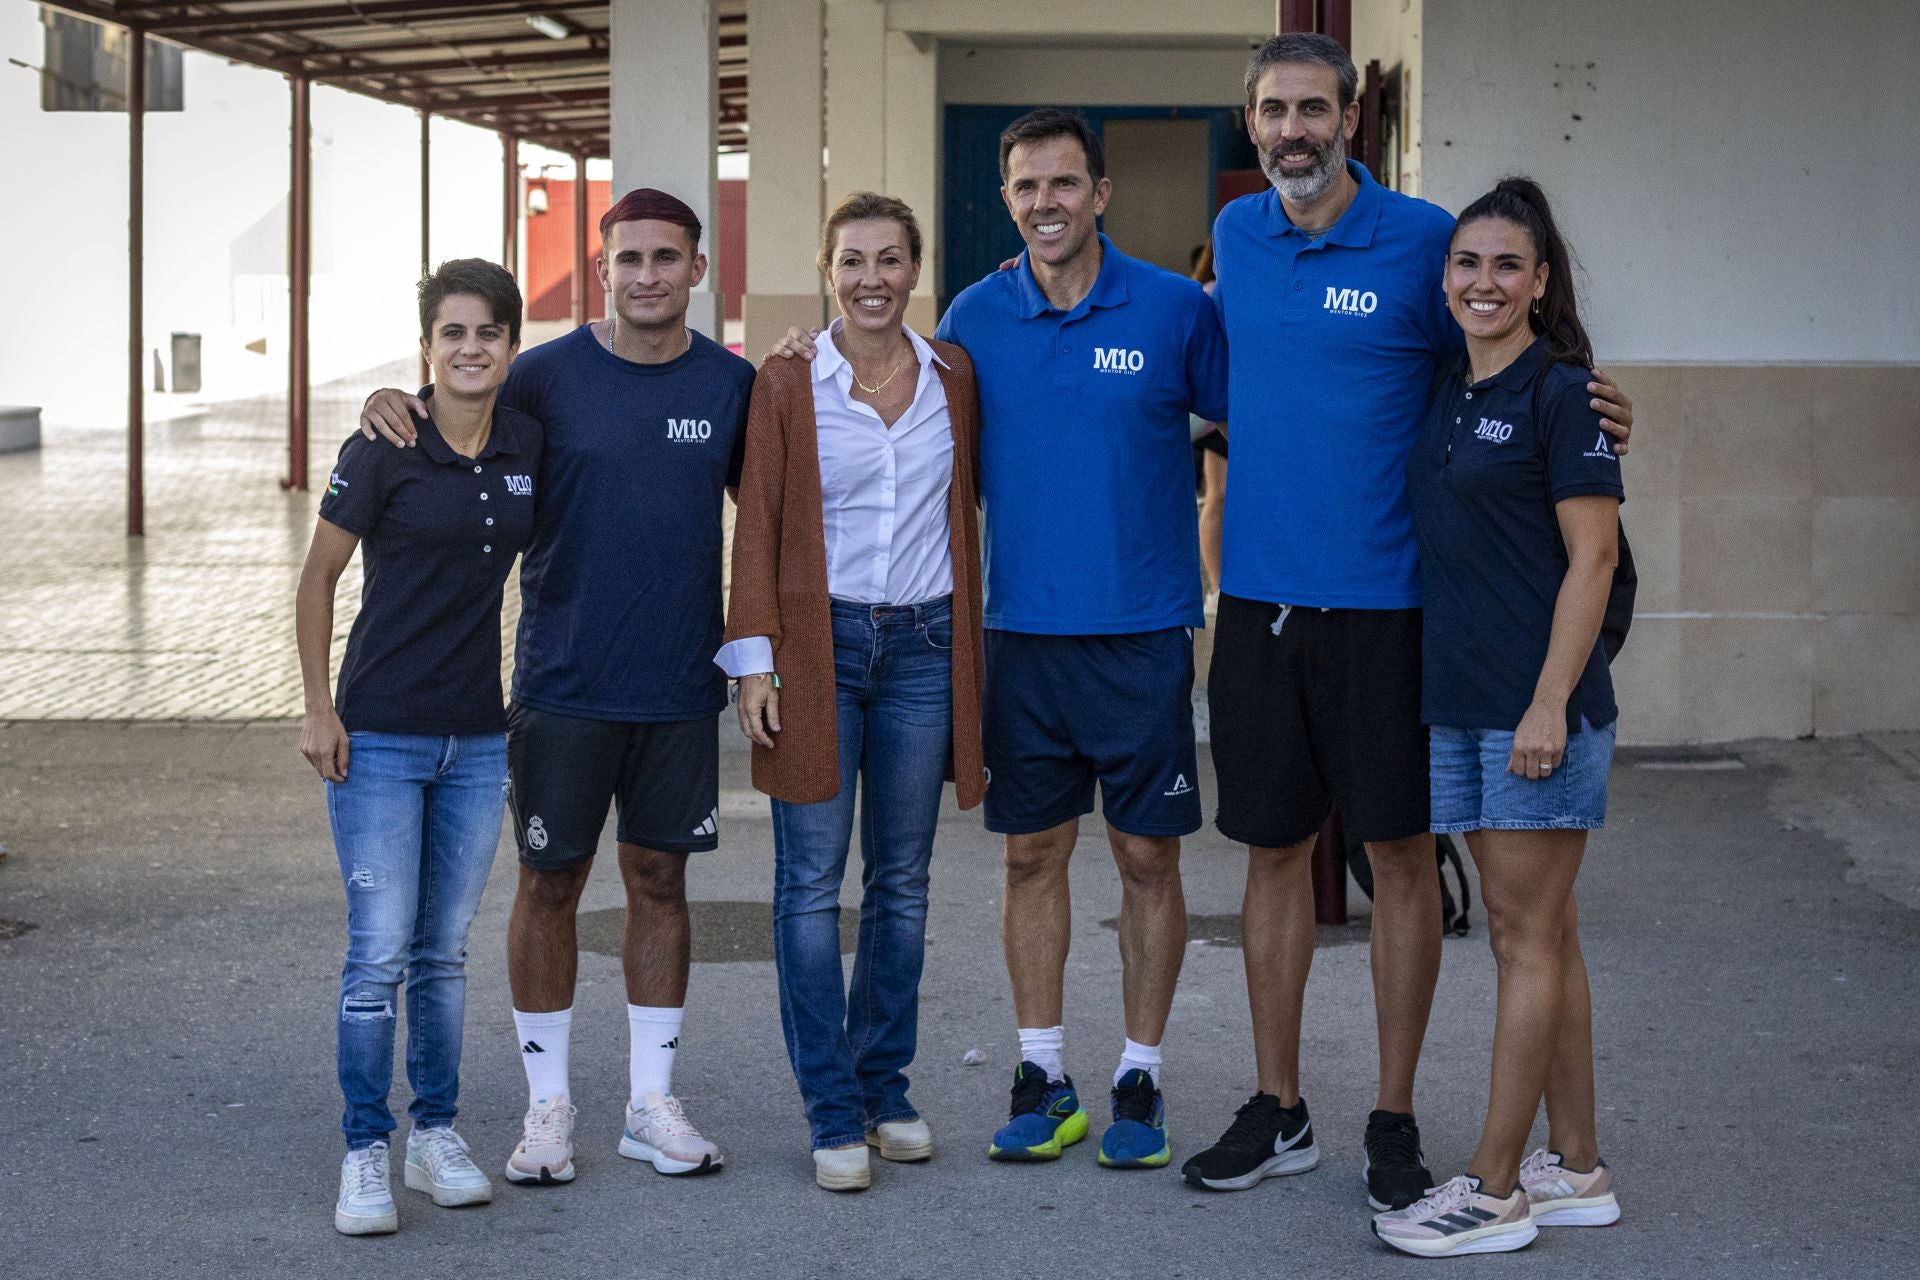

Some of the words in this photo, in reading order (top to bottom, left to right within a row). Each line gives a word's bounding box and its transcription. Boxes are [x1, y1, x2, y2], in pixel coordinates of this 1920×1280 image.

[1323, 286, 1378, 313] M10
[1093, 347, 1144, 372] M10
[667, 418, 712, 440] M10
[1474, 417, 1513, 441] M10
[504, 474, 532, 493] M10
